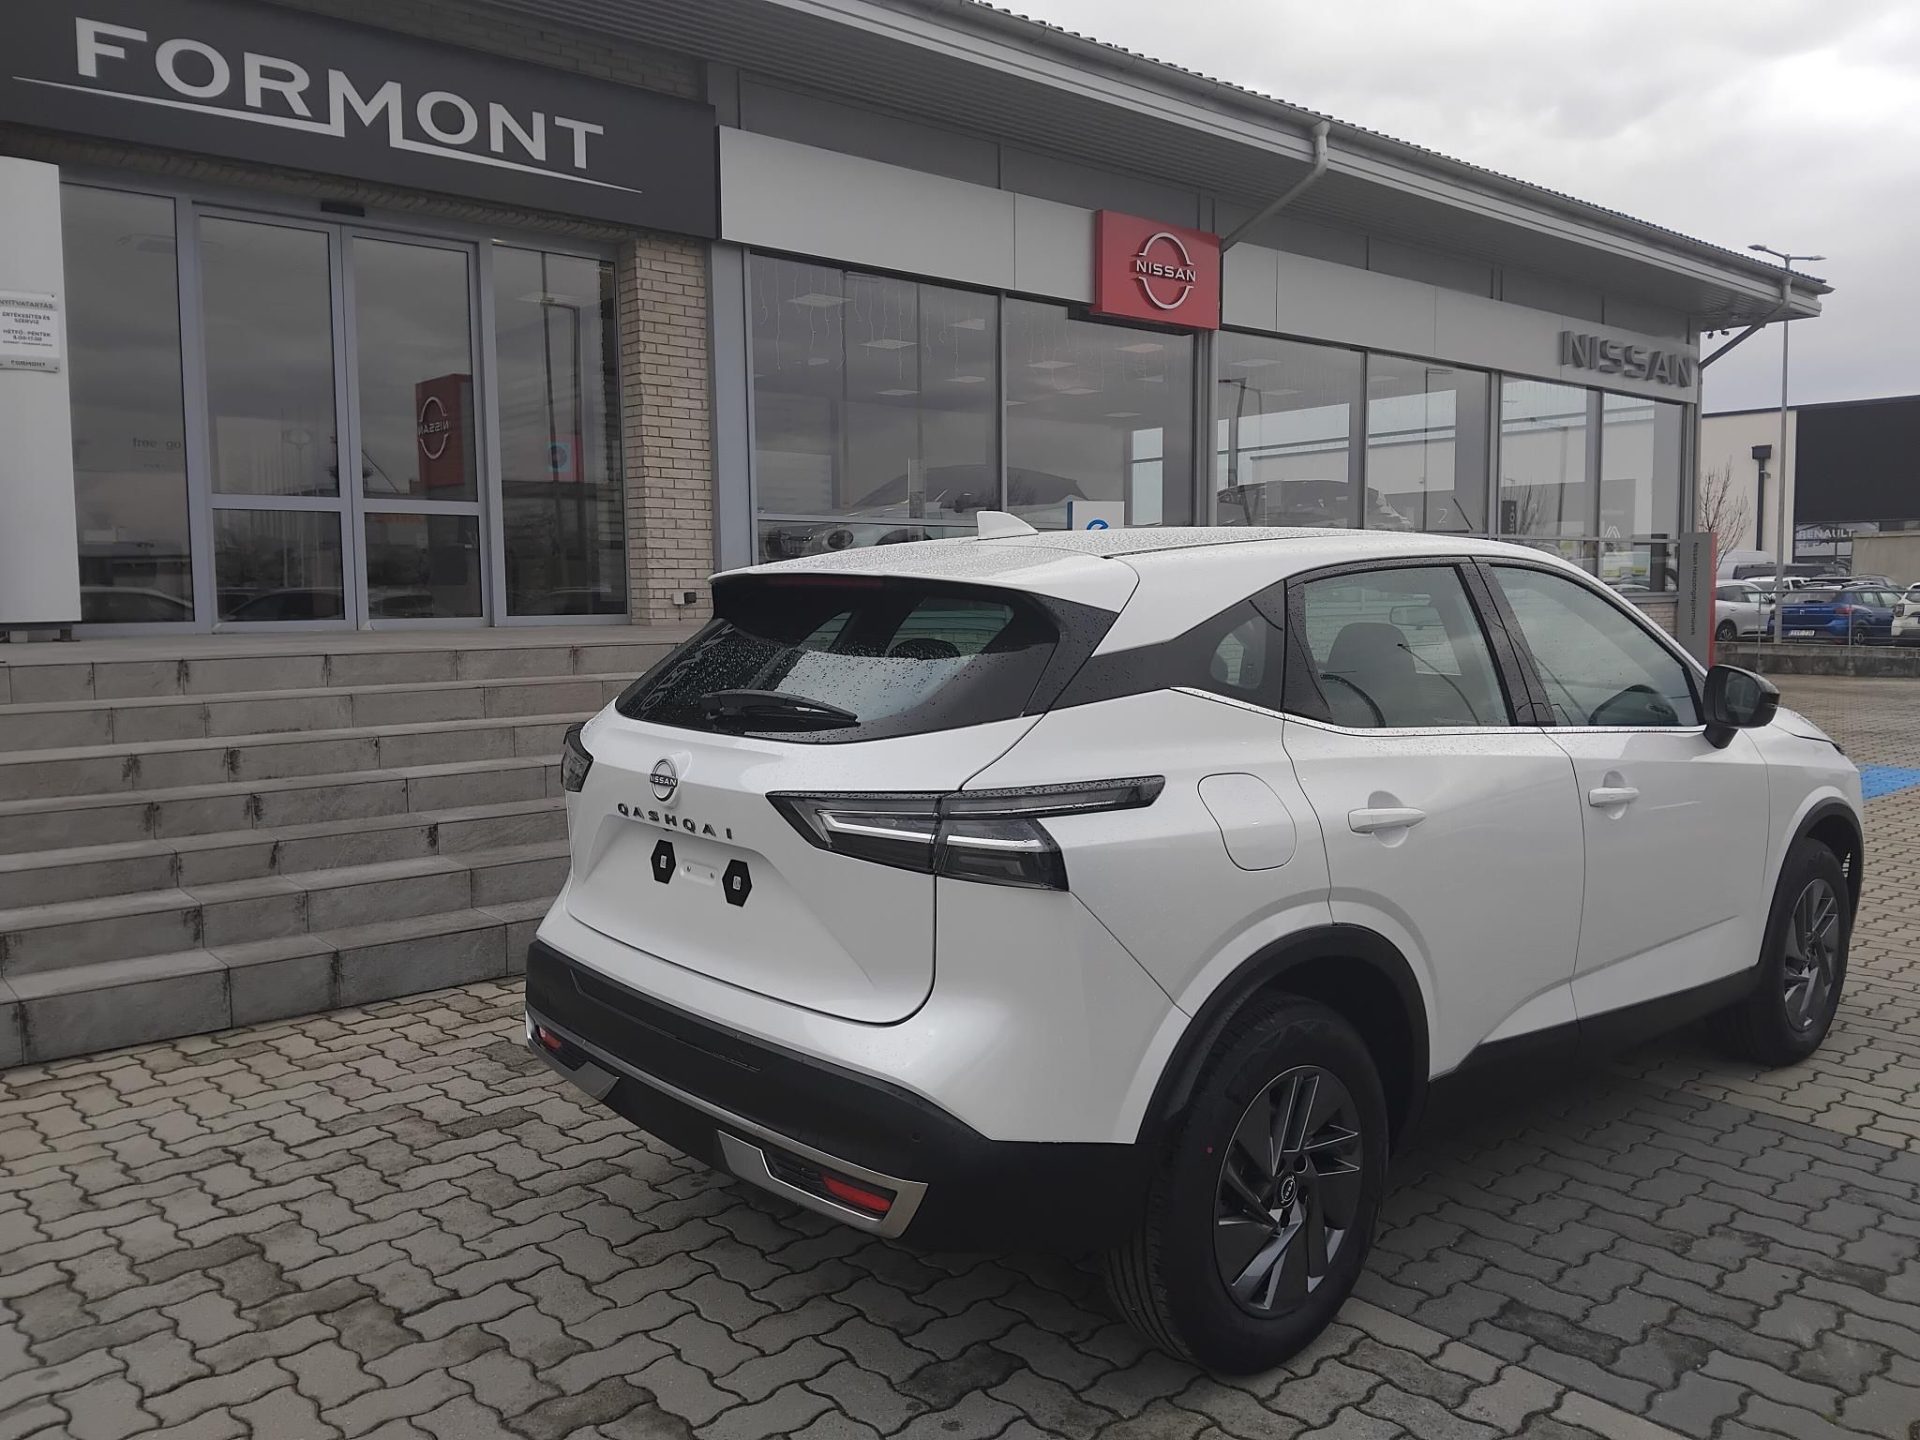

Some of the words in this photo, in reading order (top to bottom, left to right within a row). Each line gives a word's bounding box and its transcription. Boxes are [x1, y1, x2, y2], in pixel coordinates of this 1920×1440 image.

[75, 18, 605, 169] FORMONT
[1135, 259, 1197, 282] NISSAN
[1560, 330, 1694, 388] NISSAN
[1798, 528, 1855, 539] RENAULT
[617, 803, 733, 840] QASHQAI
